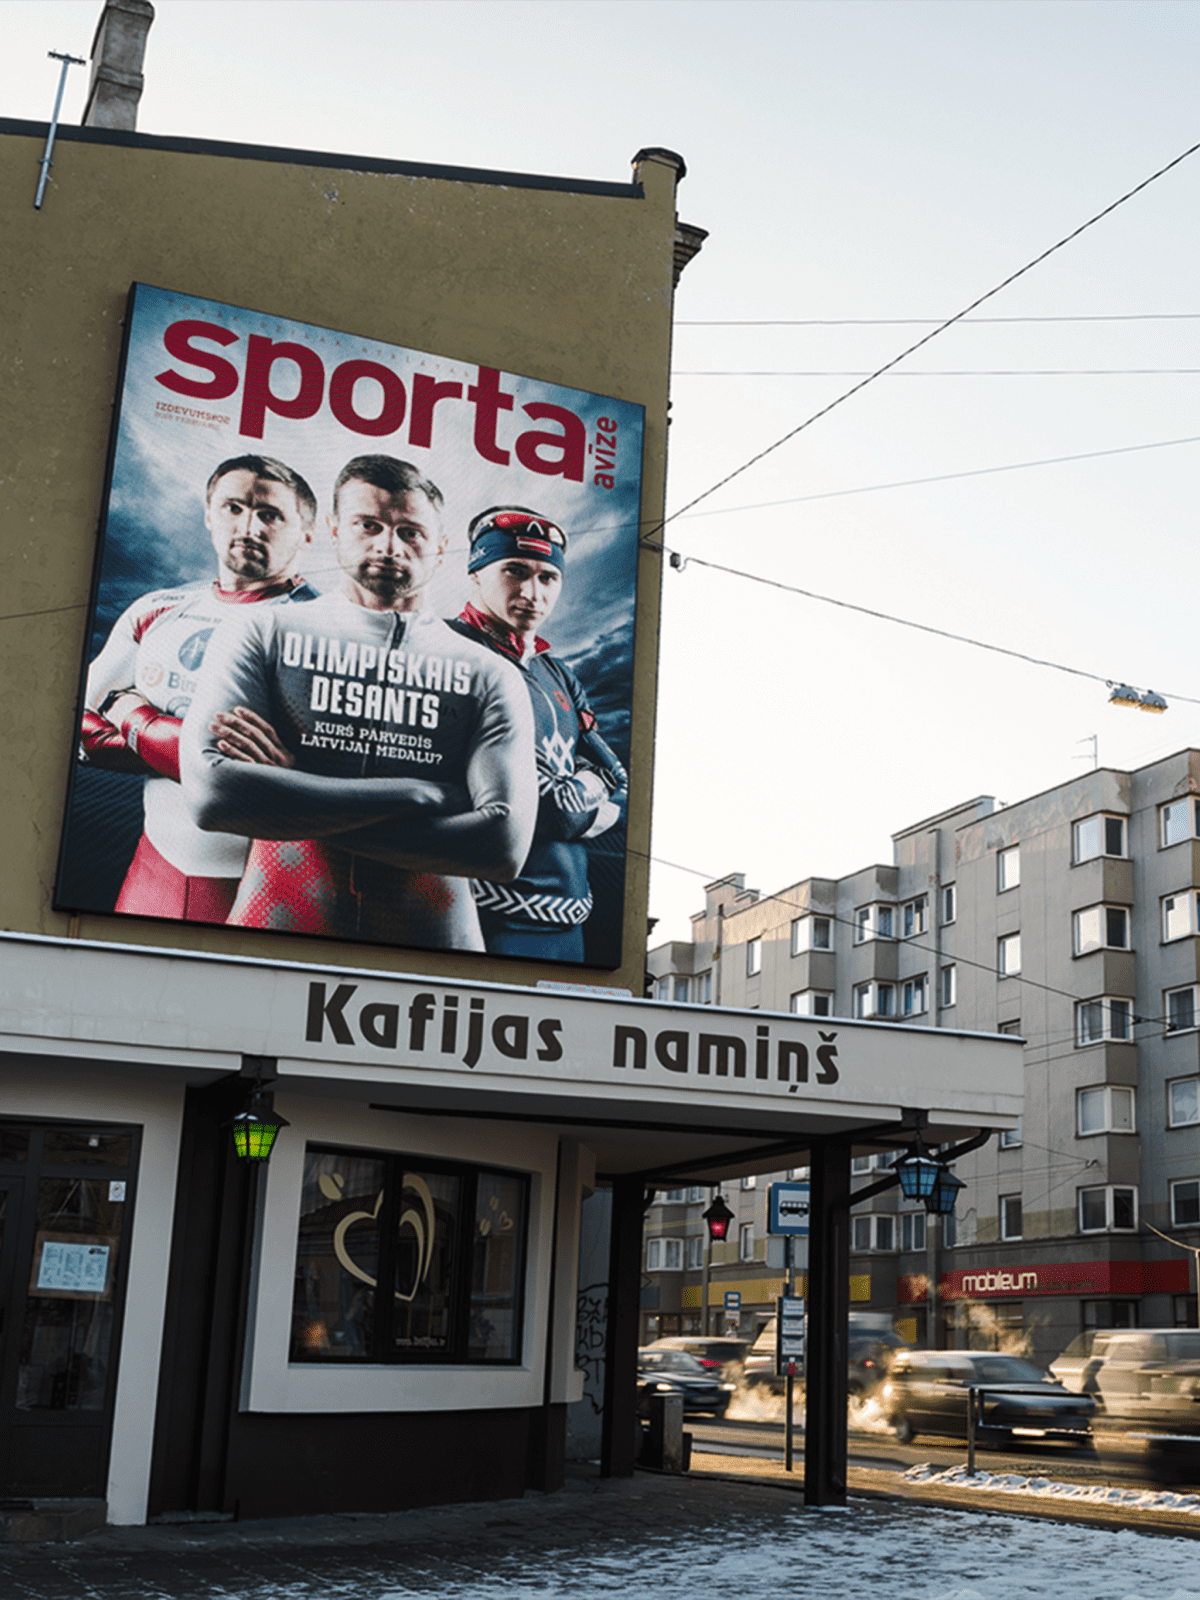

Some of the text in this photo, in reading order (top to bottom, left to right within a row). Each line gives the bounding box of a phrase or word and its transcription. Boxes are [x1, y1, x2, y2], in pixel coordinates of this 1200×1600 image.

[154, 319, 586, 482] sporta
[588, 416, 618, 490] avīze
[283, 631, 471, 695] OLIMPISKAIS
[310, 675, 440, 729] DESANTS
[314, 720, 355, 737] KURŠ
[301, 733, 371, 755] LATVIJAI
[305, 981, 839, 1093] Kafijas namiņš
